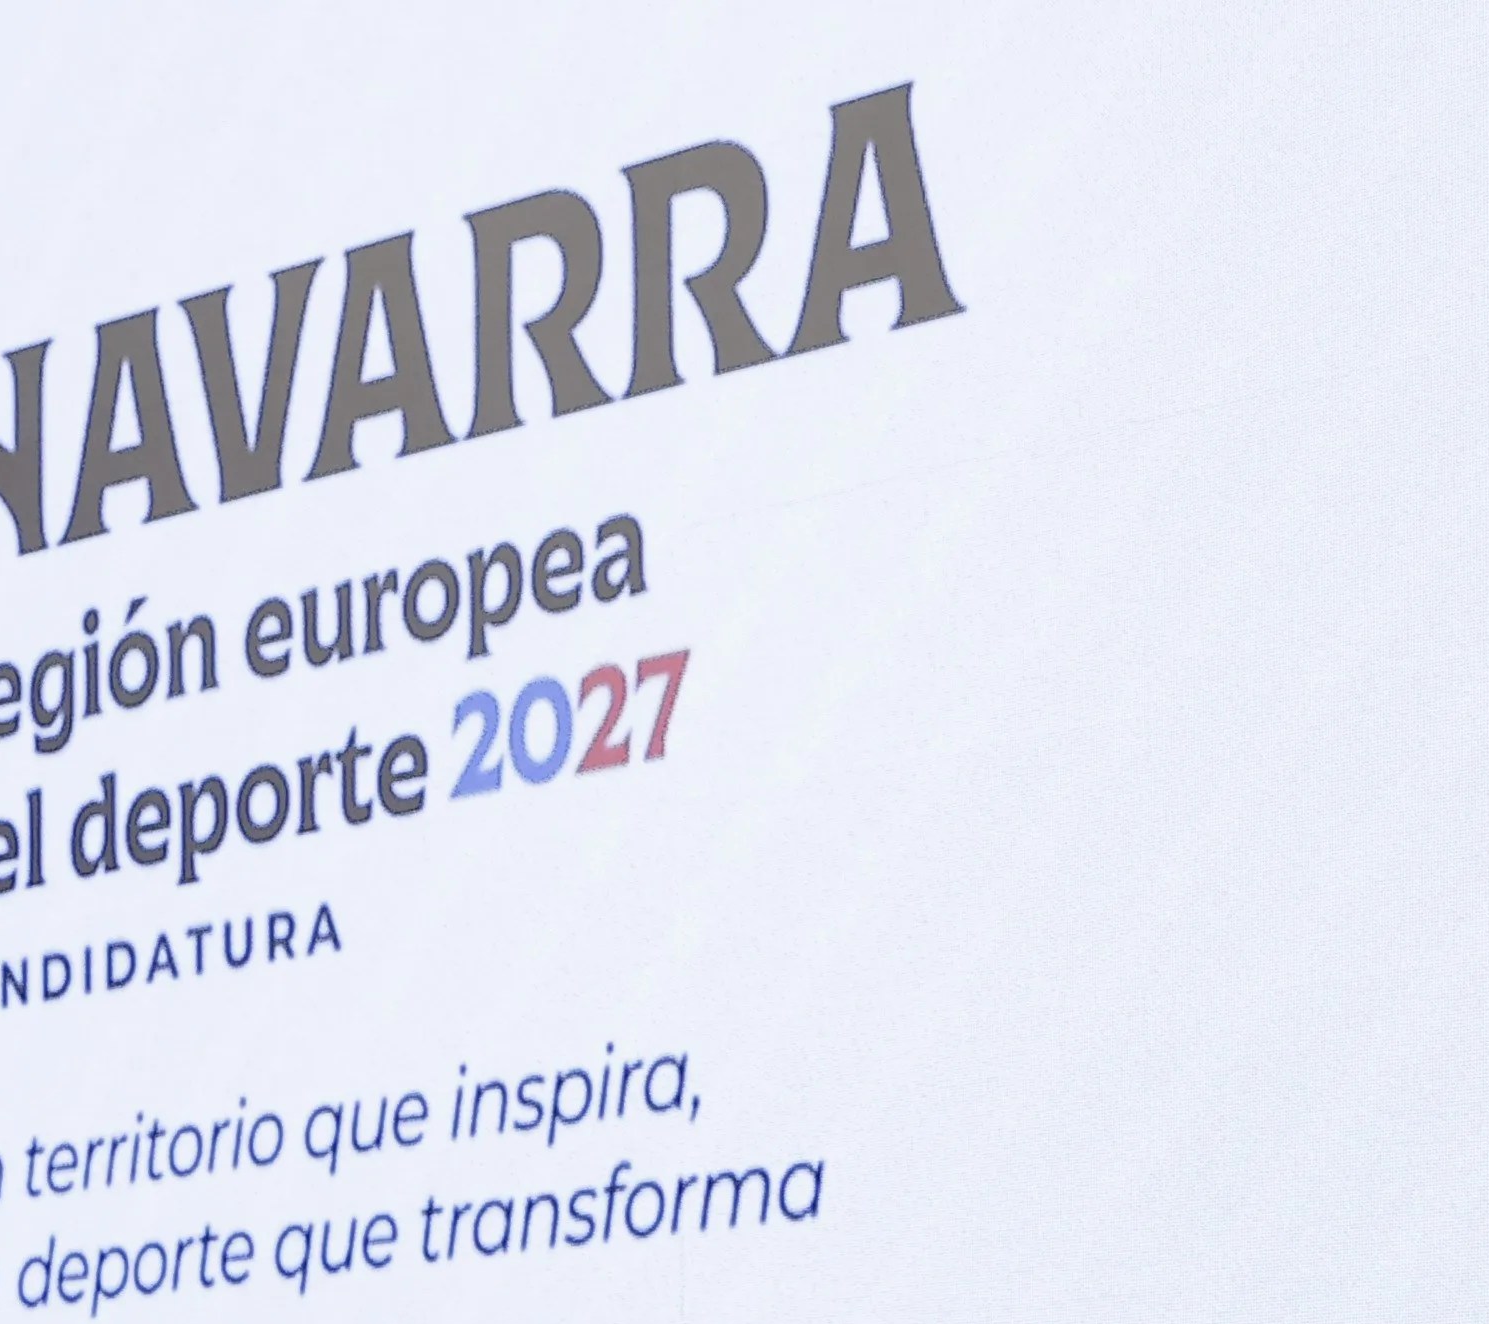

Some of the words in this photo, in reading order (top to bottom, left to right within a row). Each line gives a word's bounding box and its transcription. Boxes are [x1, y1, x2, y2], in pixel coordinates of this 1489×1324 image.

[245, 513, 649, 676] europea
[69, 726, 429, 888] deporte
[450, 641, 690, 799] 2027
[26, 1097, 283, 1197] territorio
[305, 1092, 428, 1167] que
[452, 1042, 700, 1147] inspira,
[18, 1226, 254, 1317] deporte
[275, 1214, 398, 1295] que
[421, 1154, 824, 1264] transforma
